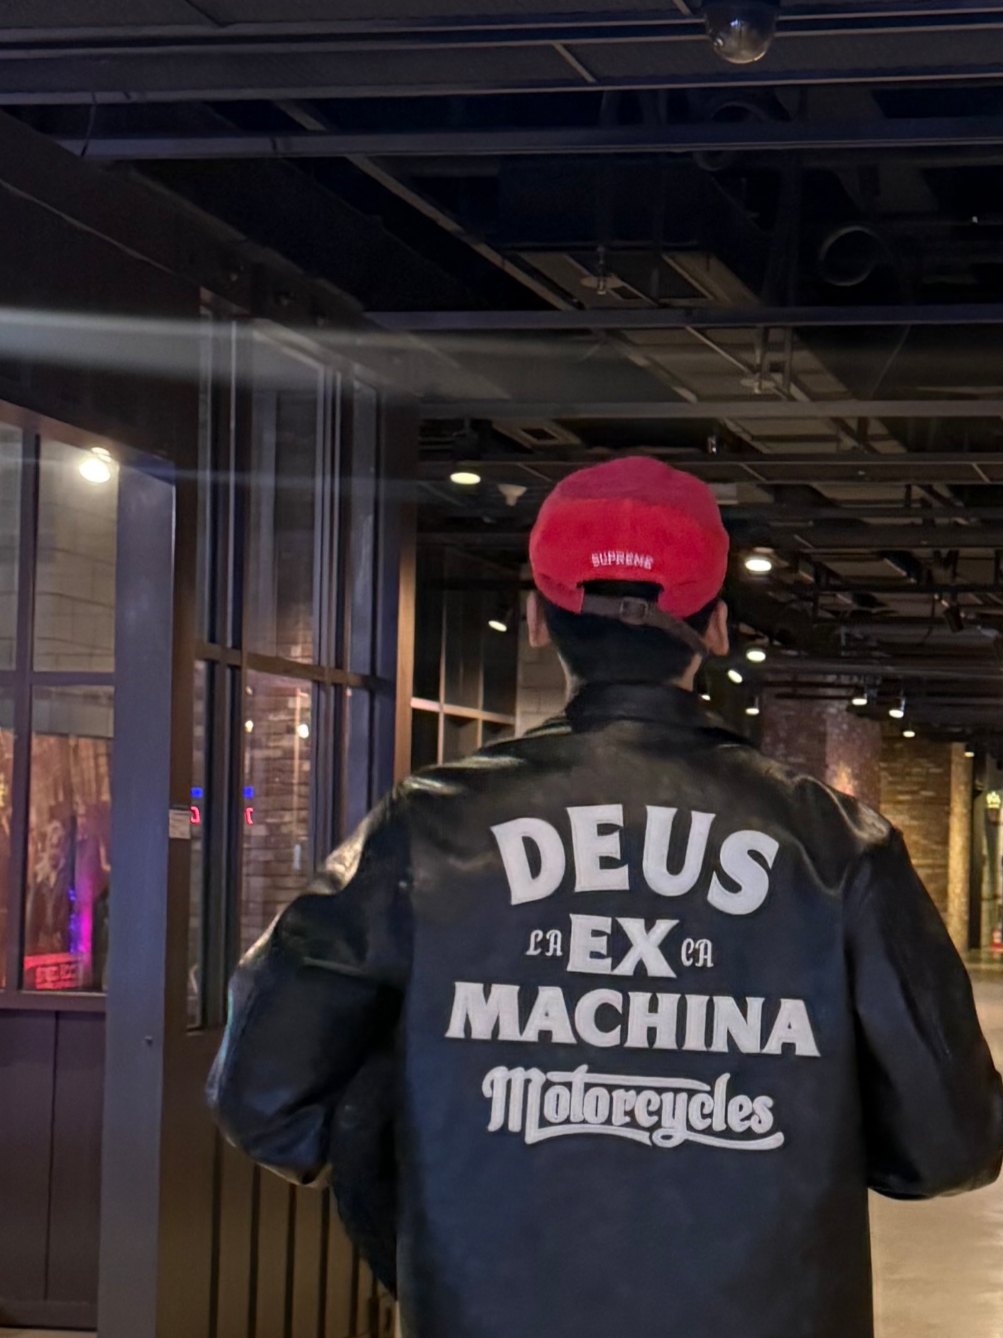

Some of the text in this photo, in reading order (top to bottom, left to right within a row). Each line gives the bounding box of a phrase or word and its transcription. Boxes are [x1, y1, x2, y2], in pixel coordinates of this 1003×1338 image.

[490, 803, 780, 916] DEUS
[525, 912, 714, 978] LA EX CA
[444, 981, 822, 1057] MACHINA
[481, 1064, 785, 1151] Motorcycles
